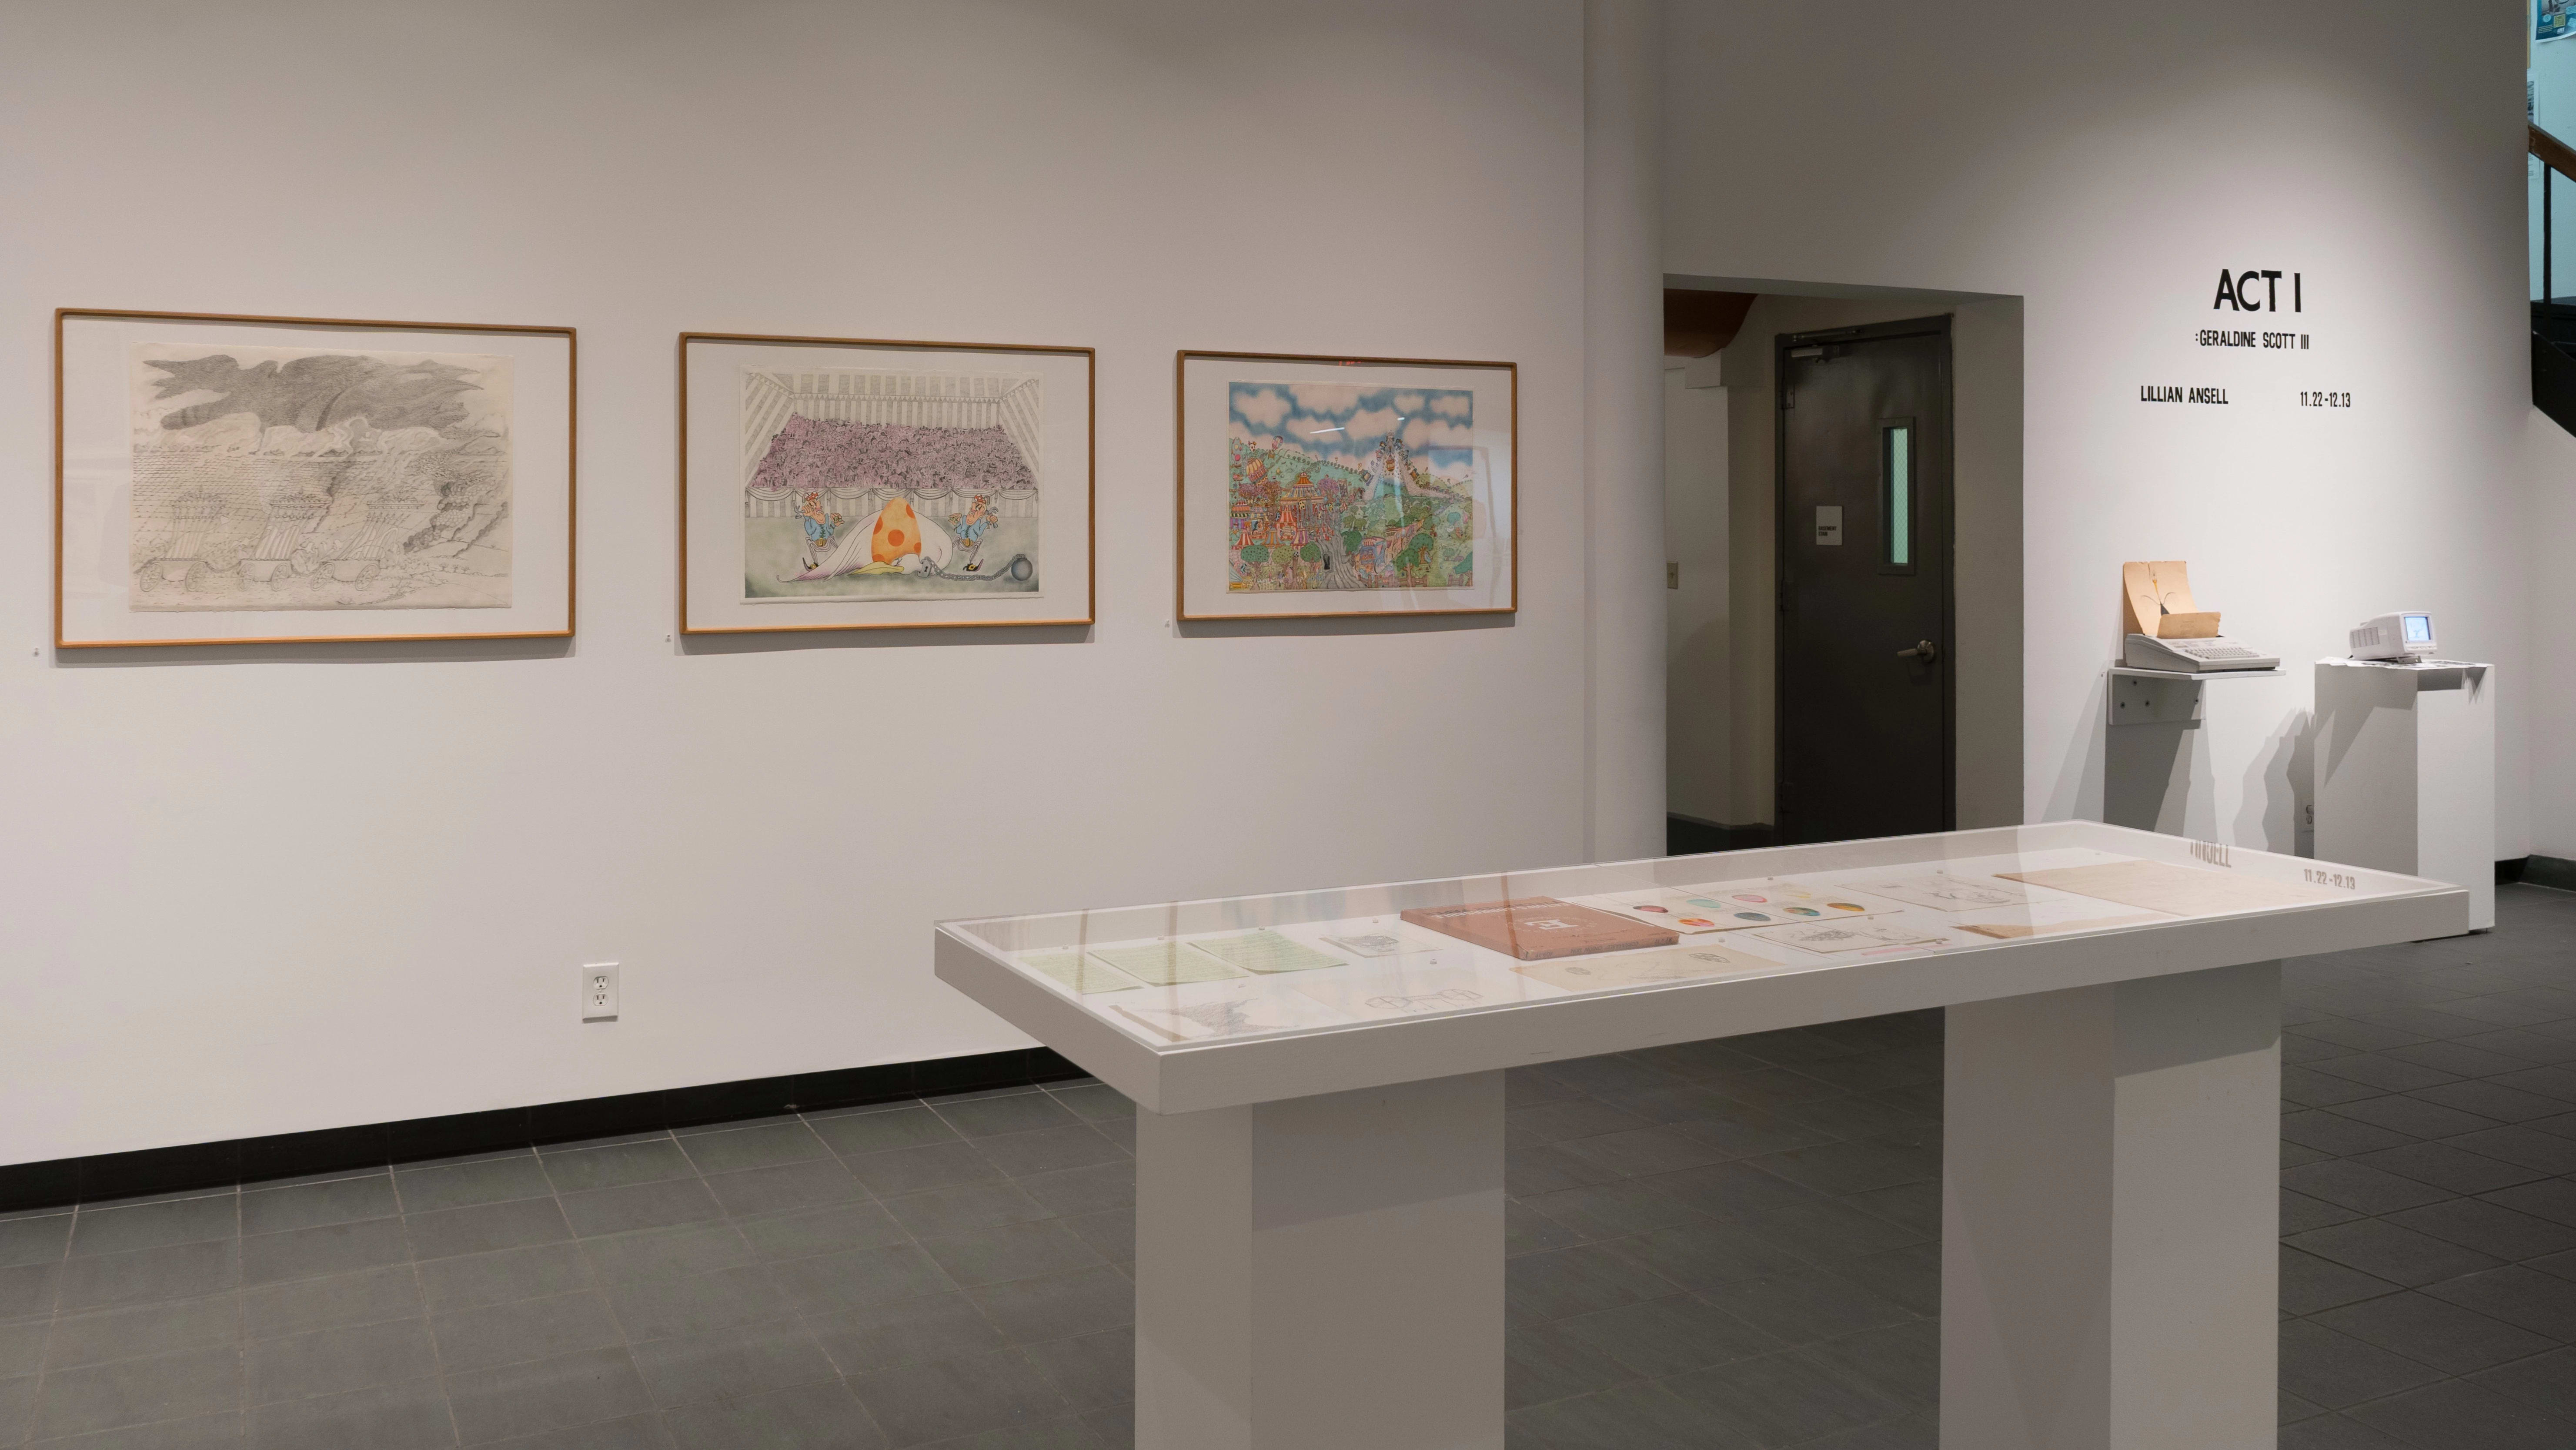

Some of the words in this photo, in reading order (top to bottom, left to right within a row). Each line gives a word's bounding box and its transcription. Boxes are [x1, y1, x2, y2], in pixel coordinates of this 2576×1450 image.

[2213, 268, 2282, 312] ACT
[2294, 272, 2301, 313] I
[2195, 329, 2256, 348] :GERALDINE
[2263, 332, 2296, 349] SCOTT
[2301, 334, 2309, 350] III
[2141, 385, 2183, 403] LILLIAN
[2188, 387, 2229, 405] ANSELL
